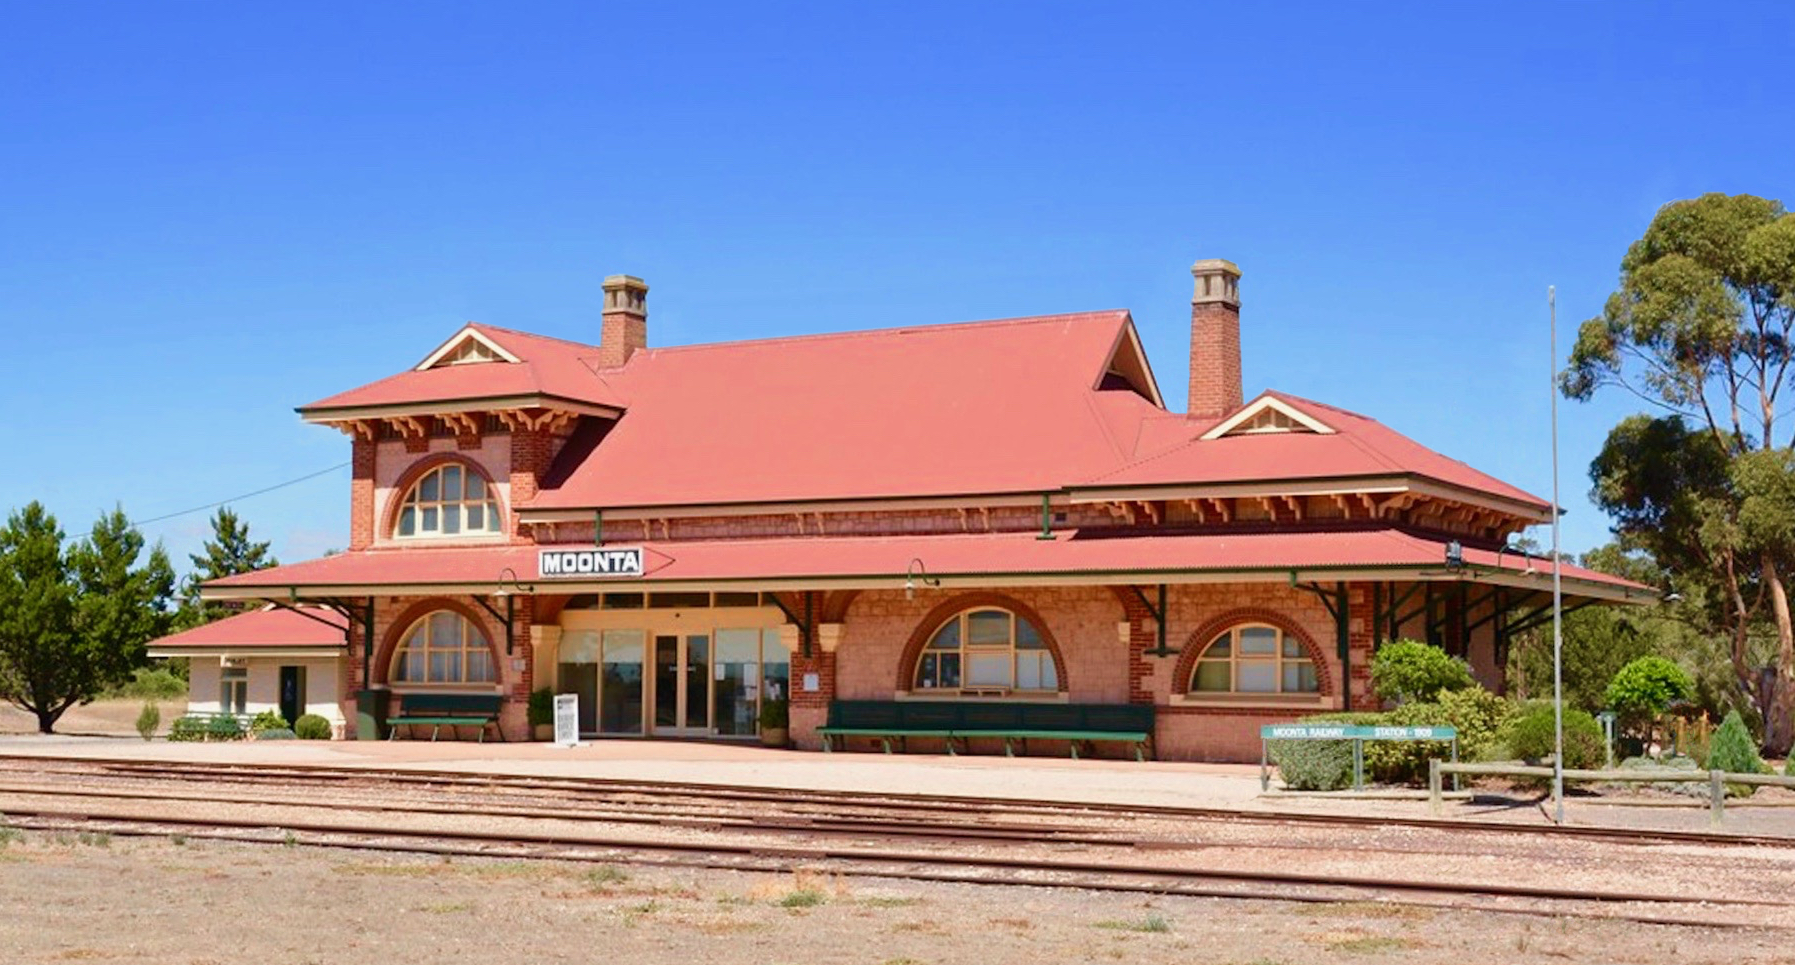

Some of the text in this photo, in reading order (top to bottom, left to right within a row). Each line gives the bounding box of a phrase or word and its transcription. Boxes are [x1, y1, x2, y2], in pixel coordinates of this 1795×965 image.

[543, 552, 639, 573] MOONTA
[1273, 727, 1306, 738] MOONTA
[1308, 727, 1344, 738] RAILWAY
[1375, 727, 1407, 738] STATION
